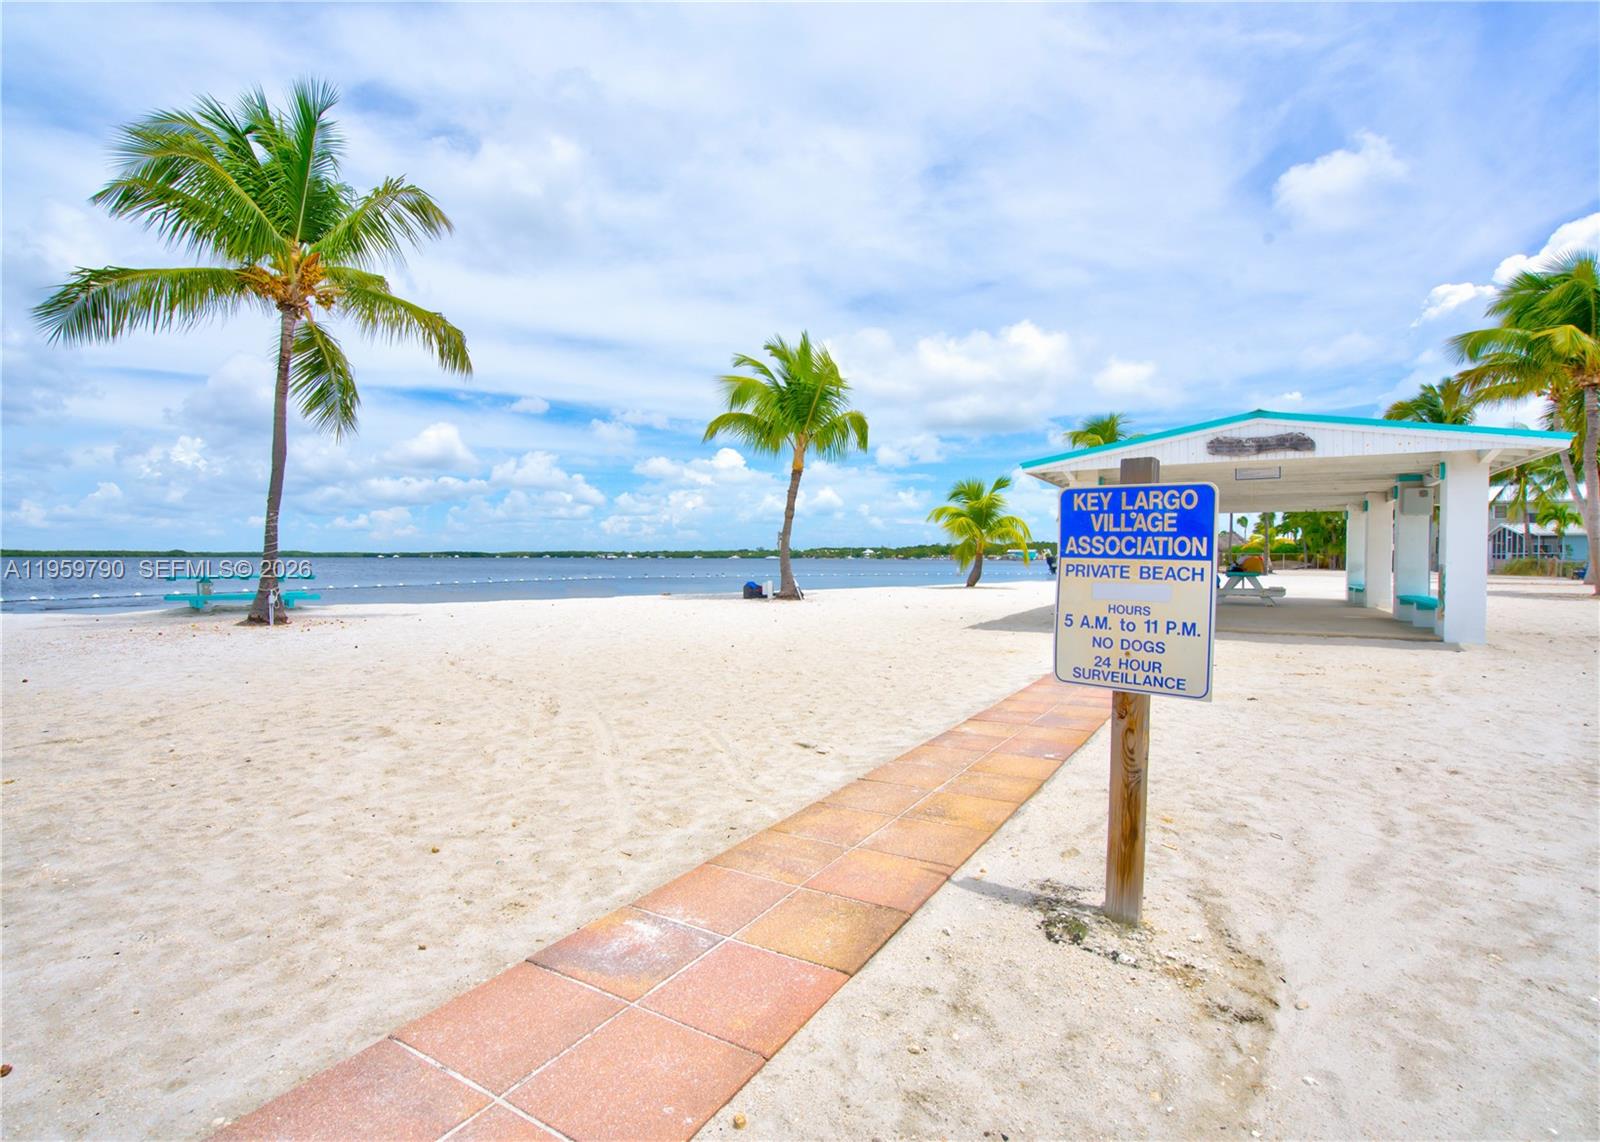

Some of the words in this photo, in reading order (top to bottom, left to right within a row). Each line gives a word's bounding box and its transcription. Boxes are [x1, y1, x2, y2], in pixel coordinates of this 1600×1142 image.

[1073, 492, 1112, 511] KEY
[1122, 489, 1199, 510] LARGO
[1091, 513, 1178, 532] VILLAGE
[1065, 536, 1207, 557] ASSOCIATION
[1065, 564, 1130, 579] PRIVATE
[1140, 566, 1204, 581] BEACH
[1108, 604, 1151, 616] HOURS
[1065, 614, 1073, 627] 5
[1080, 616, 1112, 630] A.M.
[1120, 619, 1136, 632] to
[1144, 620, 1158, 633] 11
[1166, 622, 1201, 637] P.M.
[1092, 637, 1113, 649] NO
[1121, 639, 1165, 654] DOGS
[1094, 656, 1111, 668] 24
[1119, 658, 1162, 673] HOUR
[1073, 667, 1186, 690] SURVEILLANCE
